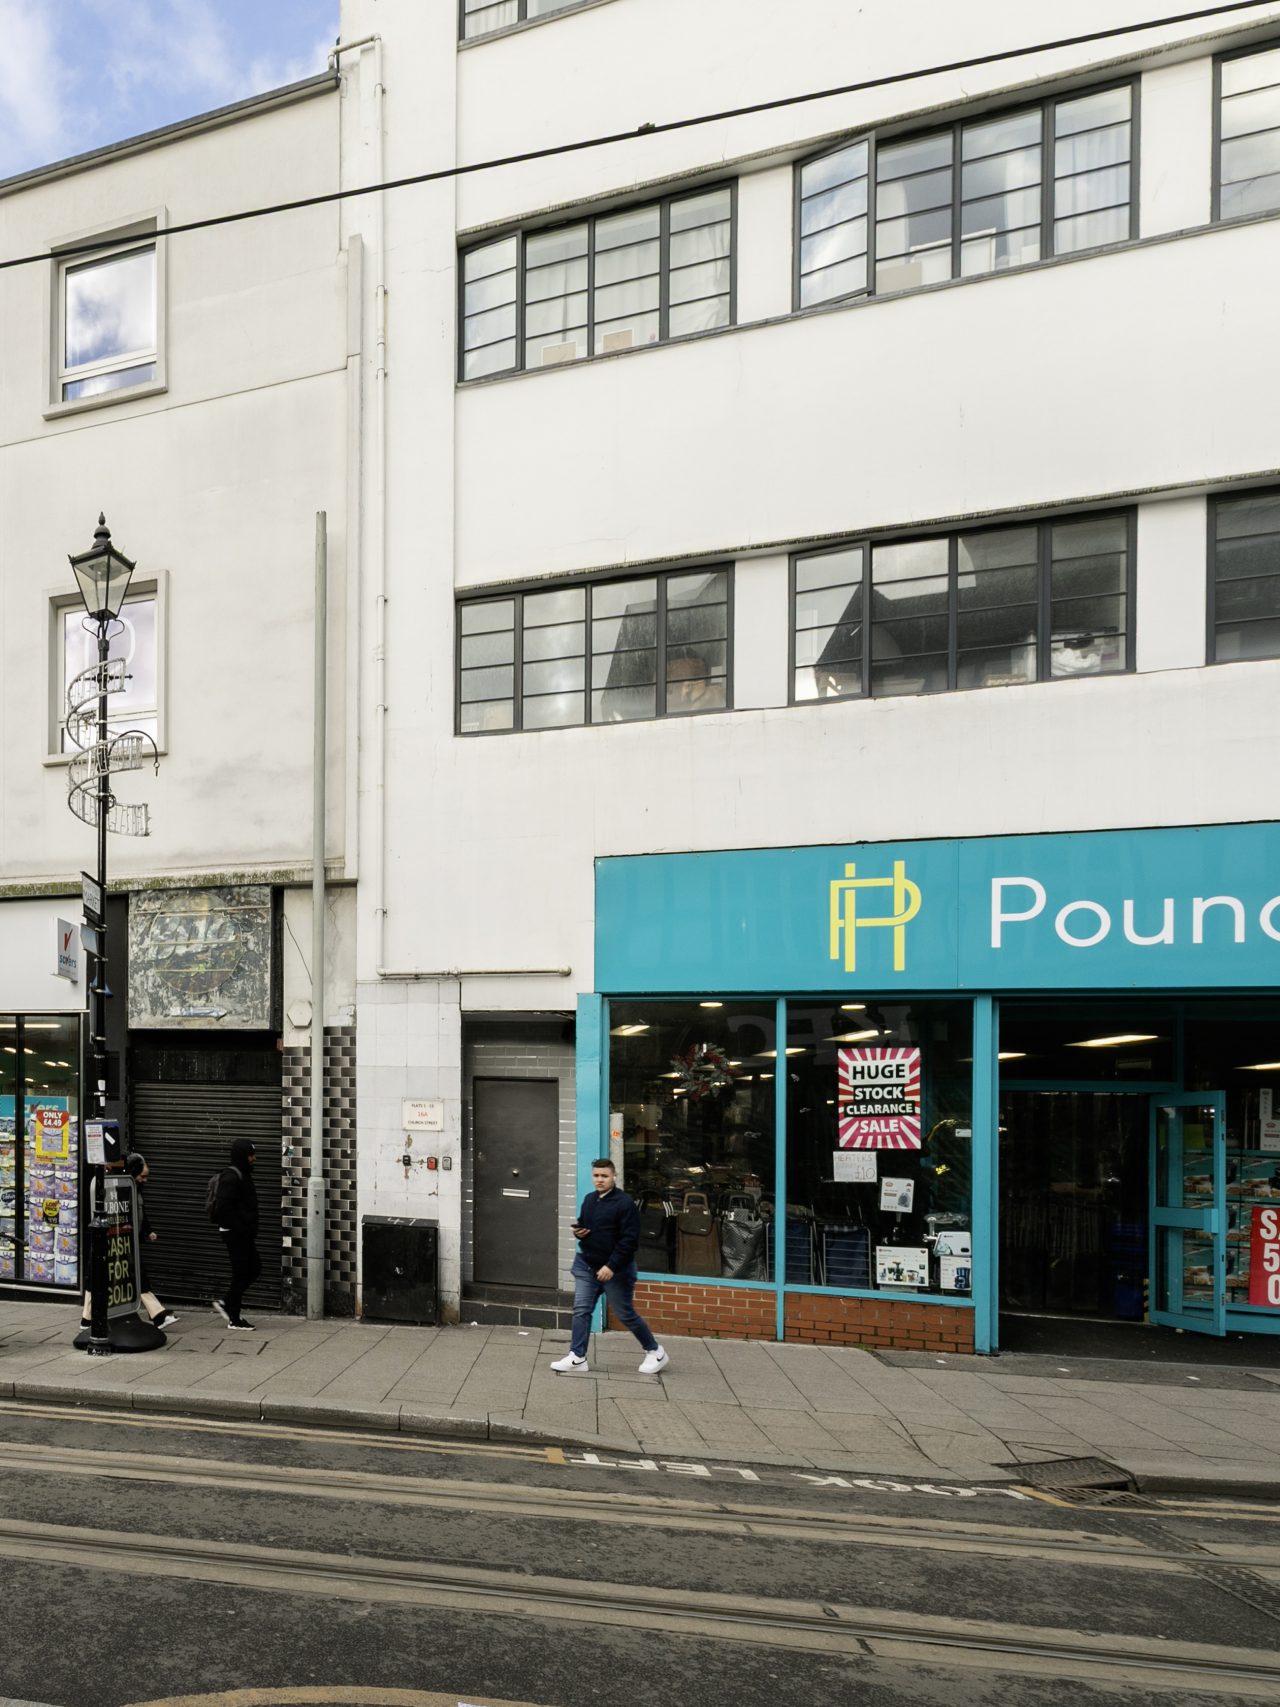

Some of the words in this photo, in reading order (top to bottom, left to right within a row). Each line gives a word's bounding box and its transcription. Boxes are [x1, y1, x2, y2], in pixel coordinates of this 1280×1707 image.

[852, 1063, 906, 1081] HUGE
[854, 1086, 903, 1100] STOCK
[43, 1111, 63, 1119] ONLY
[846, 1103, 914, 1115] CLEARANCE
[860, 1119, 900, 1134] SALE
[1259, 1209, 1280, 1241] S
[108, 1260, 129, 1281] FOR
[568, 1453, 761, 1481] LEFT
[790, 1472, 1034, 1500] LOOK
